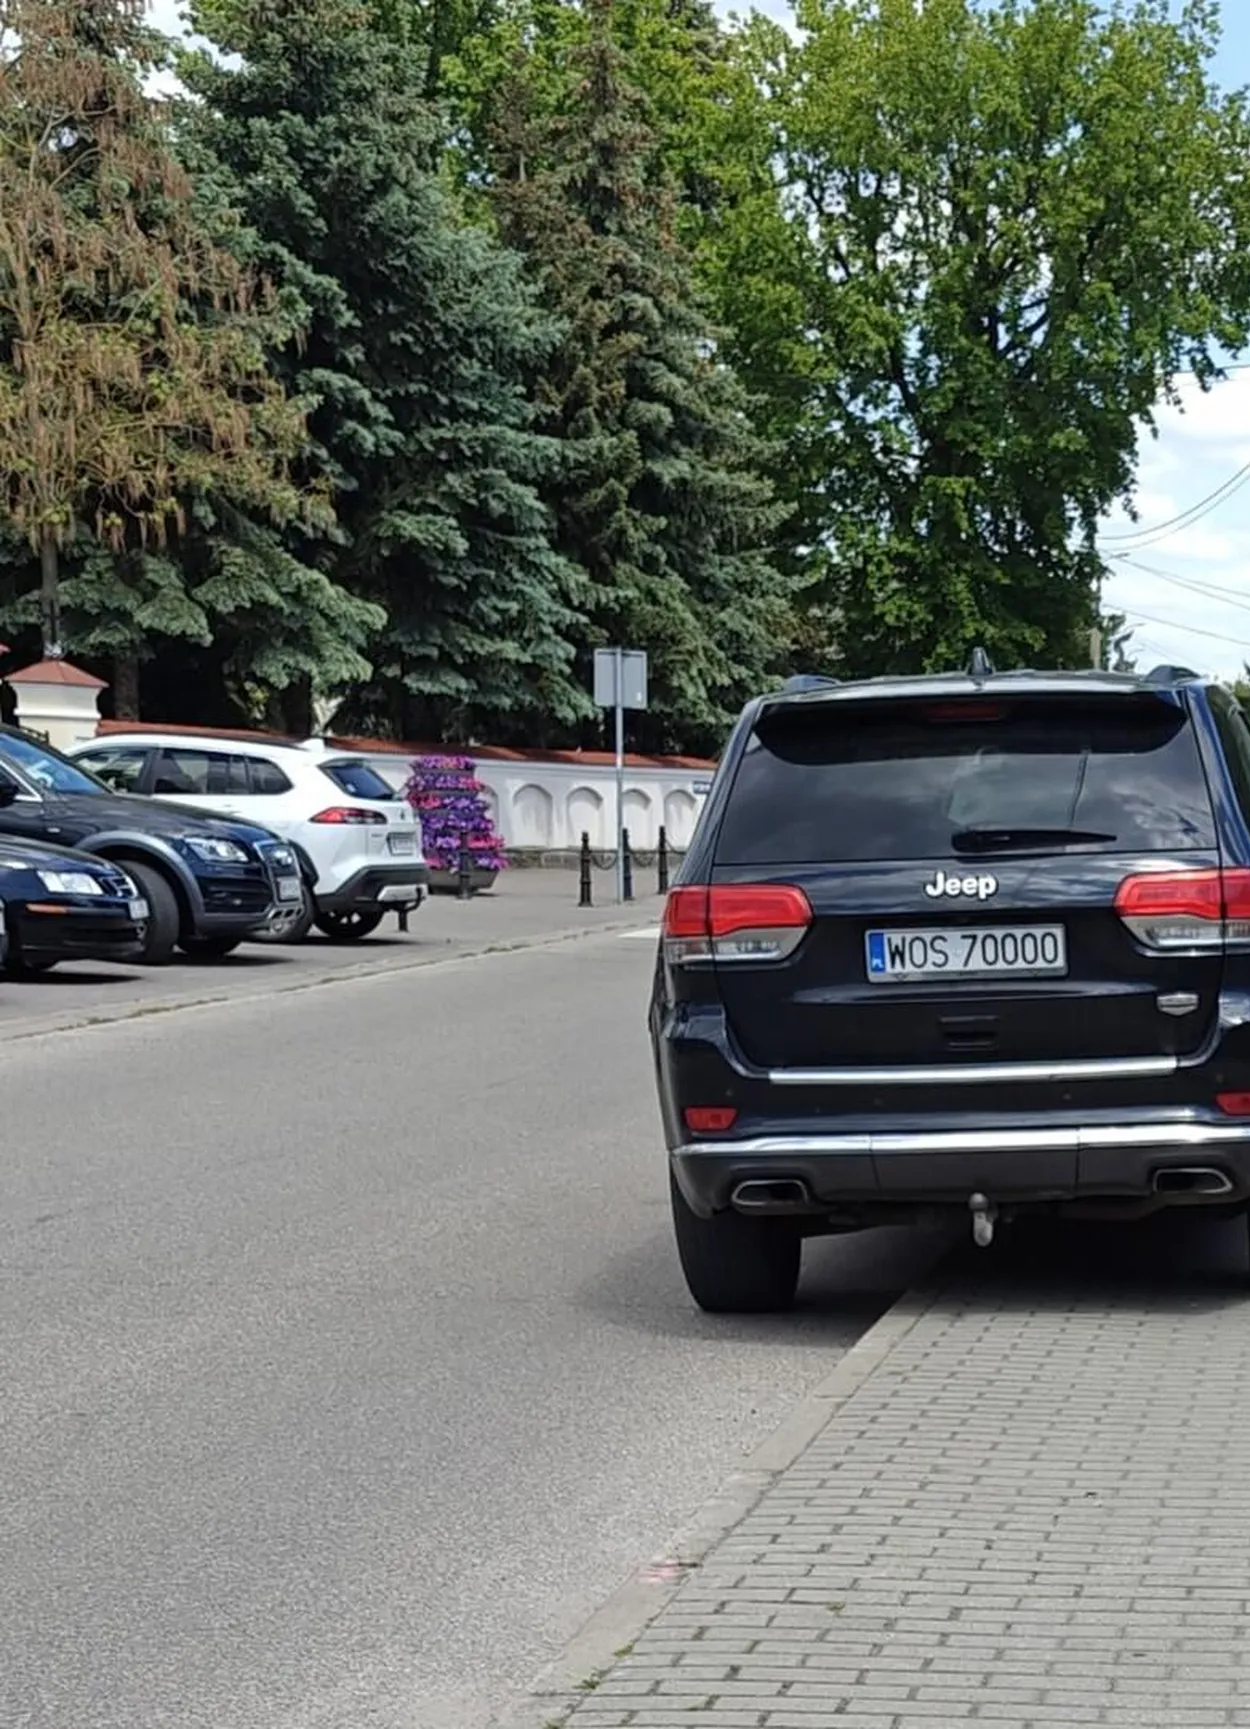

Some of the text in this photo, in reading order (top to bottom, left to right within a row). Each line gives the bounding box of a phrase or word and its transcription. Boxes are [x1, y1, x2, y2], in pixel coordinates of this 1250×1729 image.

[925, 871, 997, 899] Jeep
[887, 932, 1058, 969] WOS 70000
